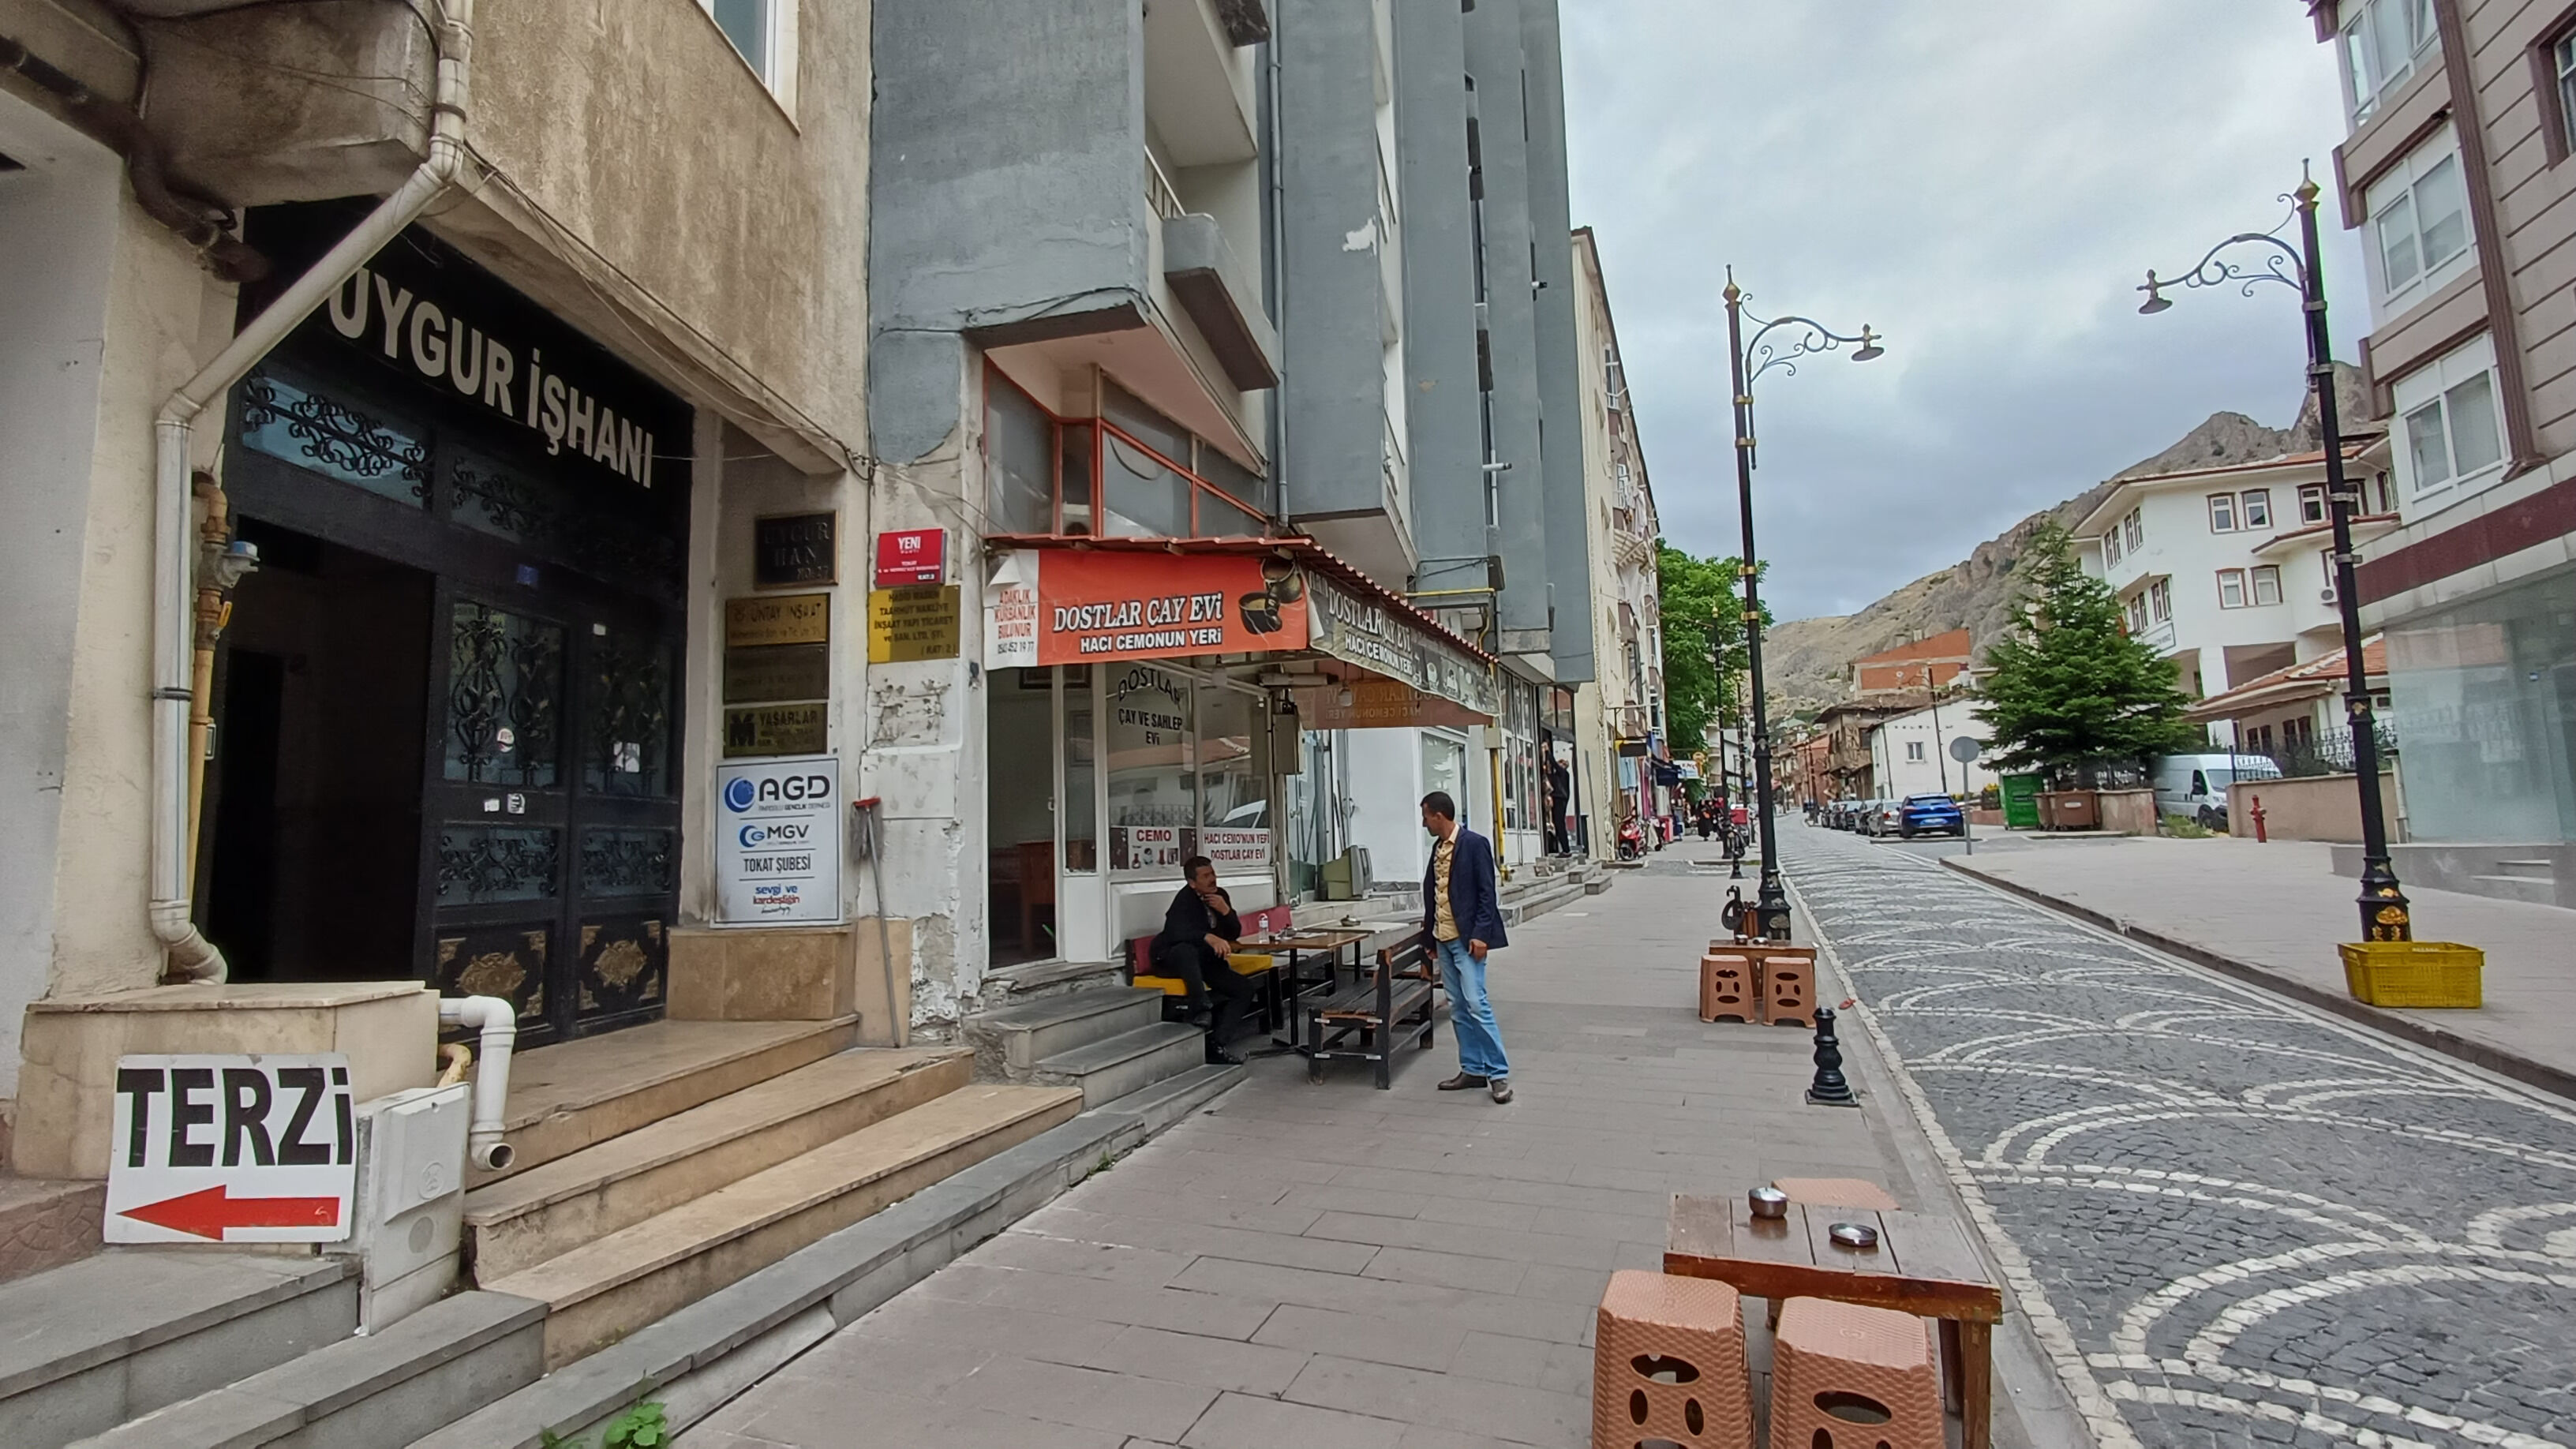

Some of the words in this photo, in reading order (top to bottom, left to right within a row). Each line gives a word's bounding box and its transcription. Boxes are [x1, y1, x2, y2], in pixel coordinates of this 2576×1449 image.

[328, 267, 515, 417] UYGUR
[527, 347, 653, 489] İŞHANI
[1053, 601, 1142, 632] DOSTLAR
[1147, 596, 1186, 627] ÇAY
[1080, 635, 1112, 653] HACI
[1116, 631, 1185, 650] CEMONUN
[1345, 632, 1365, 656] HACI
[1118, 667, 1181, 711] DOSTLAR
[1118, 708, 1136, 725] ÇAY
[1138, 710, 1149, 726] VE
[1151, 713, 1182, 731] SAHLEP
[758, 775, 830, 802] AGD
[767, 824, 809, 839] MGV
[1136, 829, 1172, 842] CEMO
[1204, 833, 1220, 844] HACI
[744, 857, 773, 872] TOKAT
[777, 853, 811, 874] ŞUBESİ
[1211, 849, 1241, 860] DOSTLAR
[755, 883, 782, 896] sevgi
